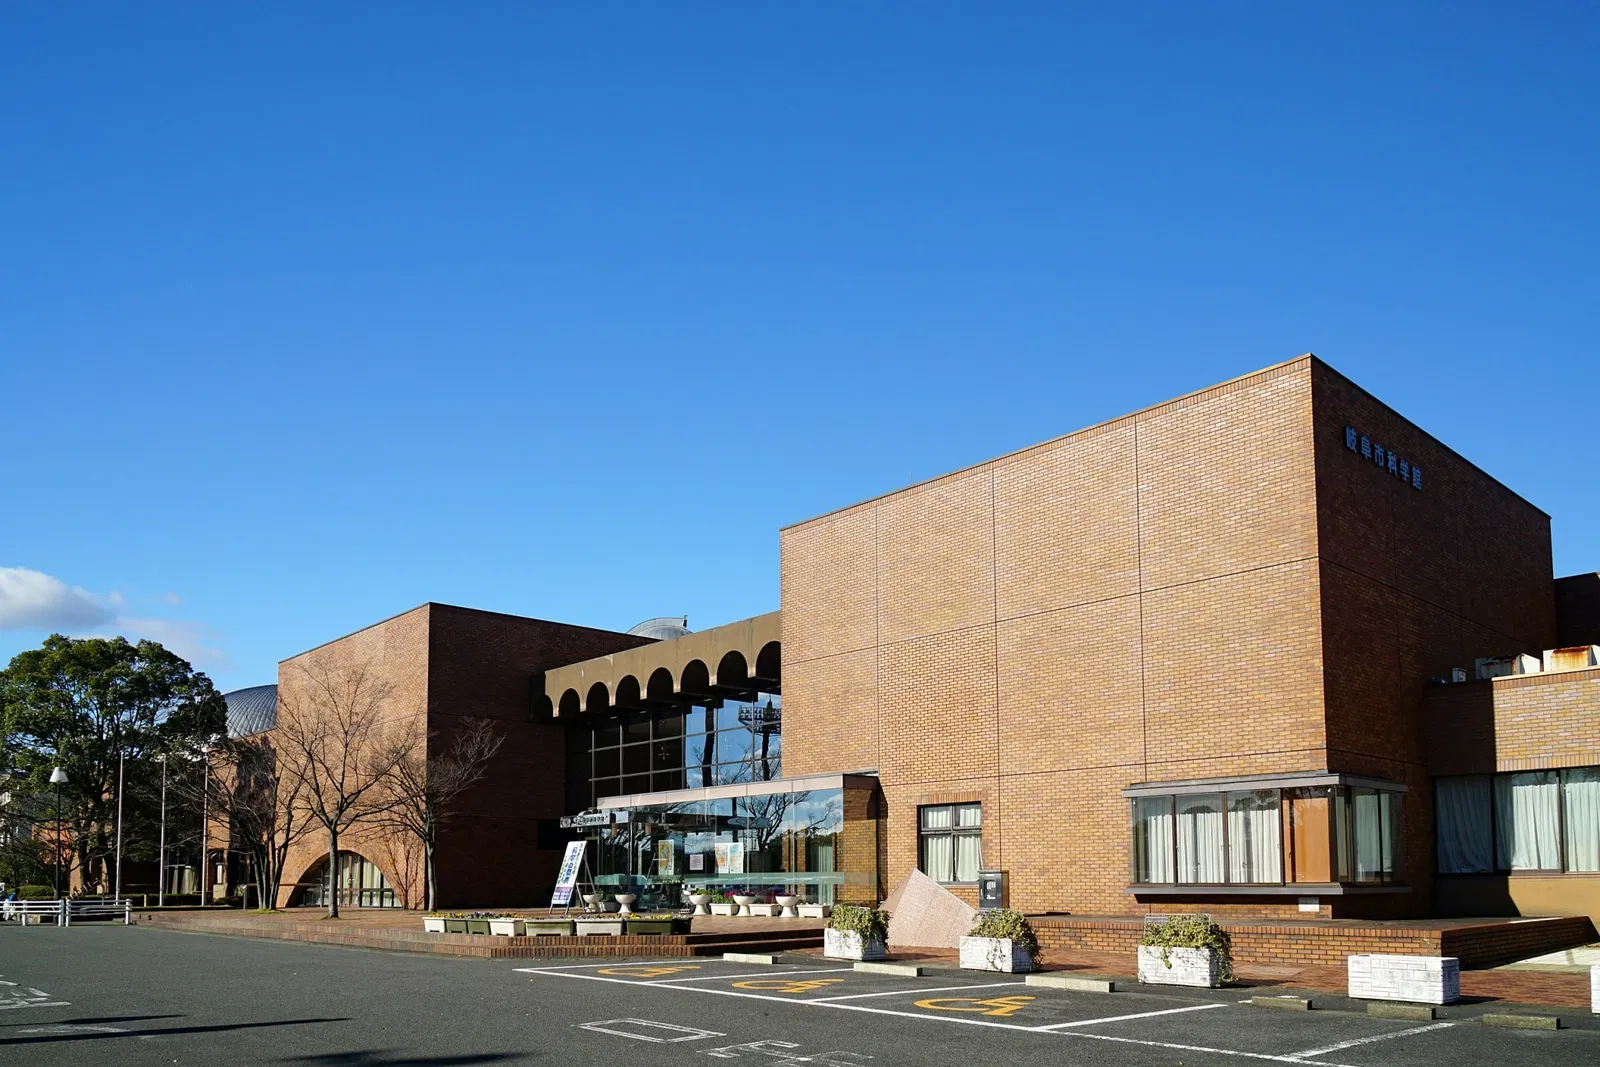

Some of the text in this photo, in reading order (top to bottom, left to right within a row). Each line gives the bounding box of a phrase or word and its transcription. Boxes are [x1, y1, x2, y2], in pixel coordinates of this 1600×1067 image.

[1345, 424, 1422, 490] 岐阜市科学館
